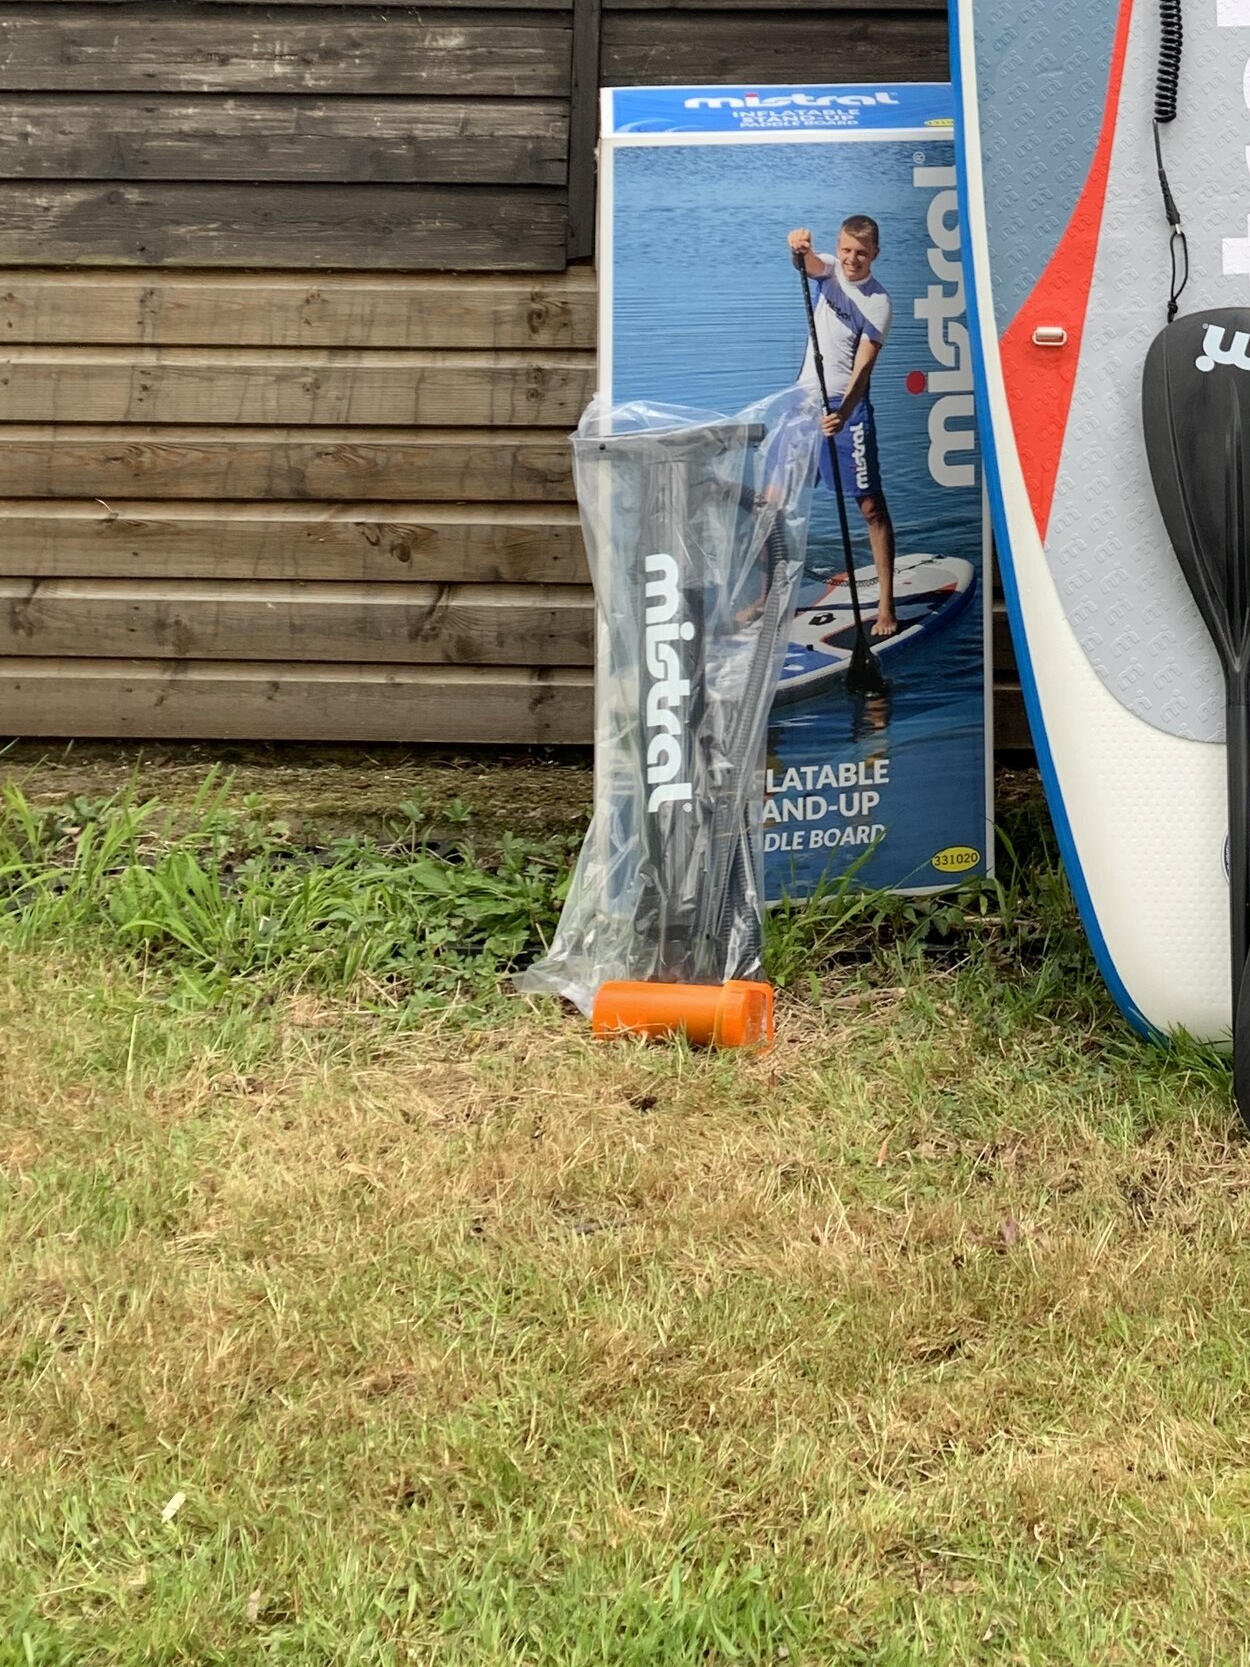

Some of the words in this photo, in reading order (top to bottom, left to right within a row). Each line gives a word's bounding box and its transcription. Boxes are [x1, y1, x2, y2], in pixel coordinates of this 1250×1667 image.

[683, 92, 900, 109] mistral
[732, 109, 860, 118] INFLATABLE
[906, 164, 975, 486] mistral
[645, 554, 695, 814] mistral
[766, 759, 890, 794] LATABLE
[762, 791, 880, 824] AND-UP
[808, 823, 887, 849] BOARD
[934, 852, 979, 866] 331020
